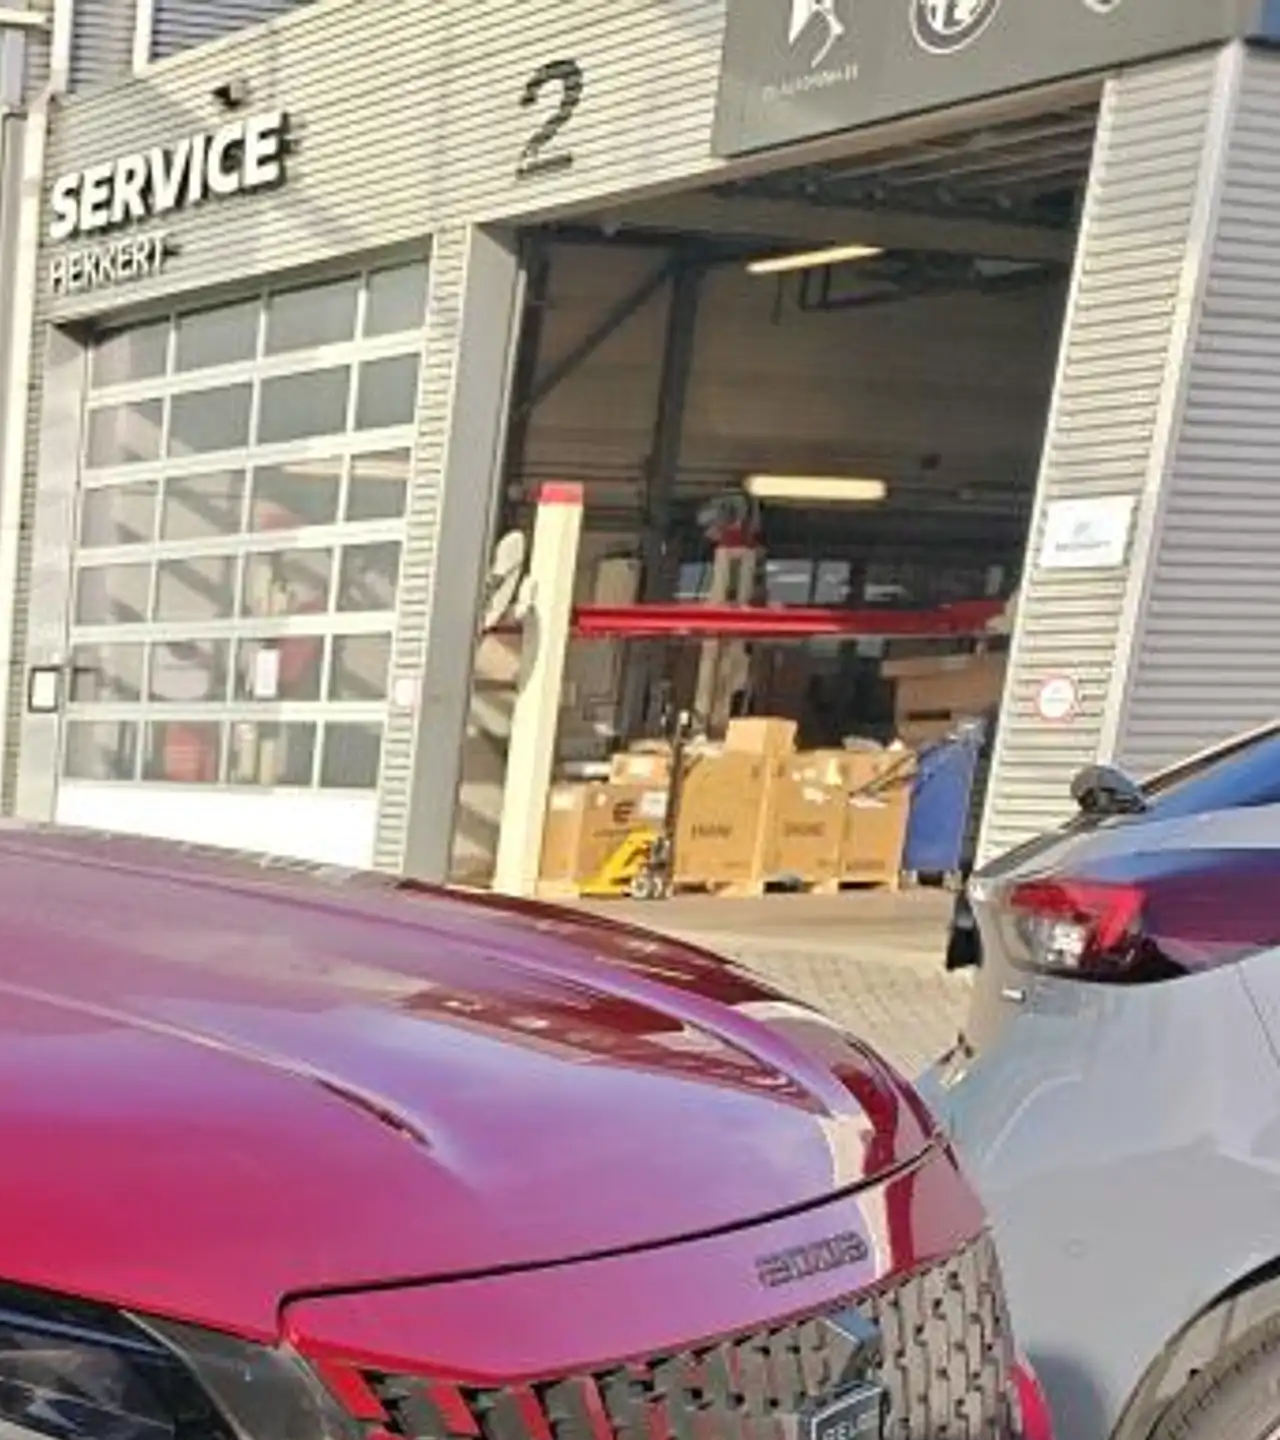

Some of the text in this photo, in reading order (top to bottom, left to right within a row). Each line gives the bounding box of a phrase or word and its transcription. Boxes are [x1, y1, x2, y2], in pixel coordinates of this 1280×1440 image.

[48, 110, 285, 241] SERVICE
[515, 58, 583, 181] 2
[48, 230, 171, 297] HEKKERT
